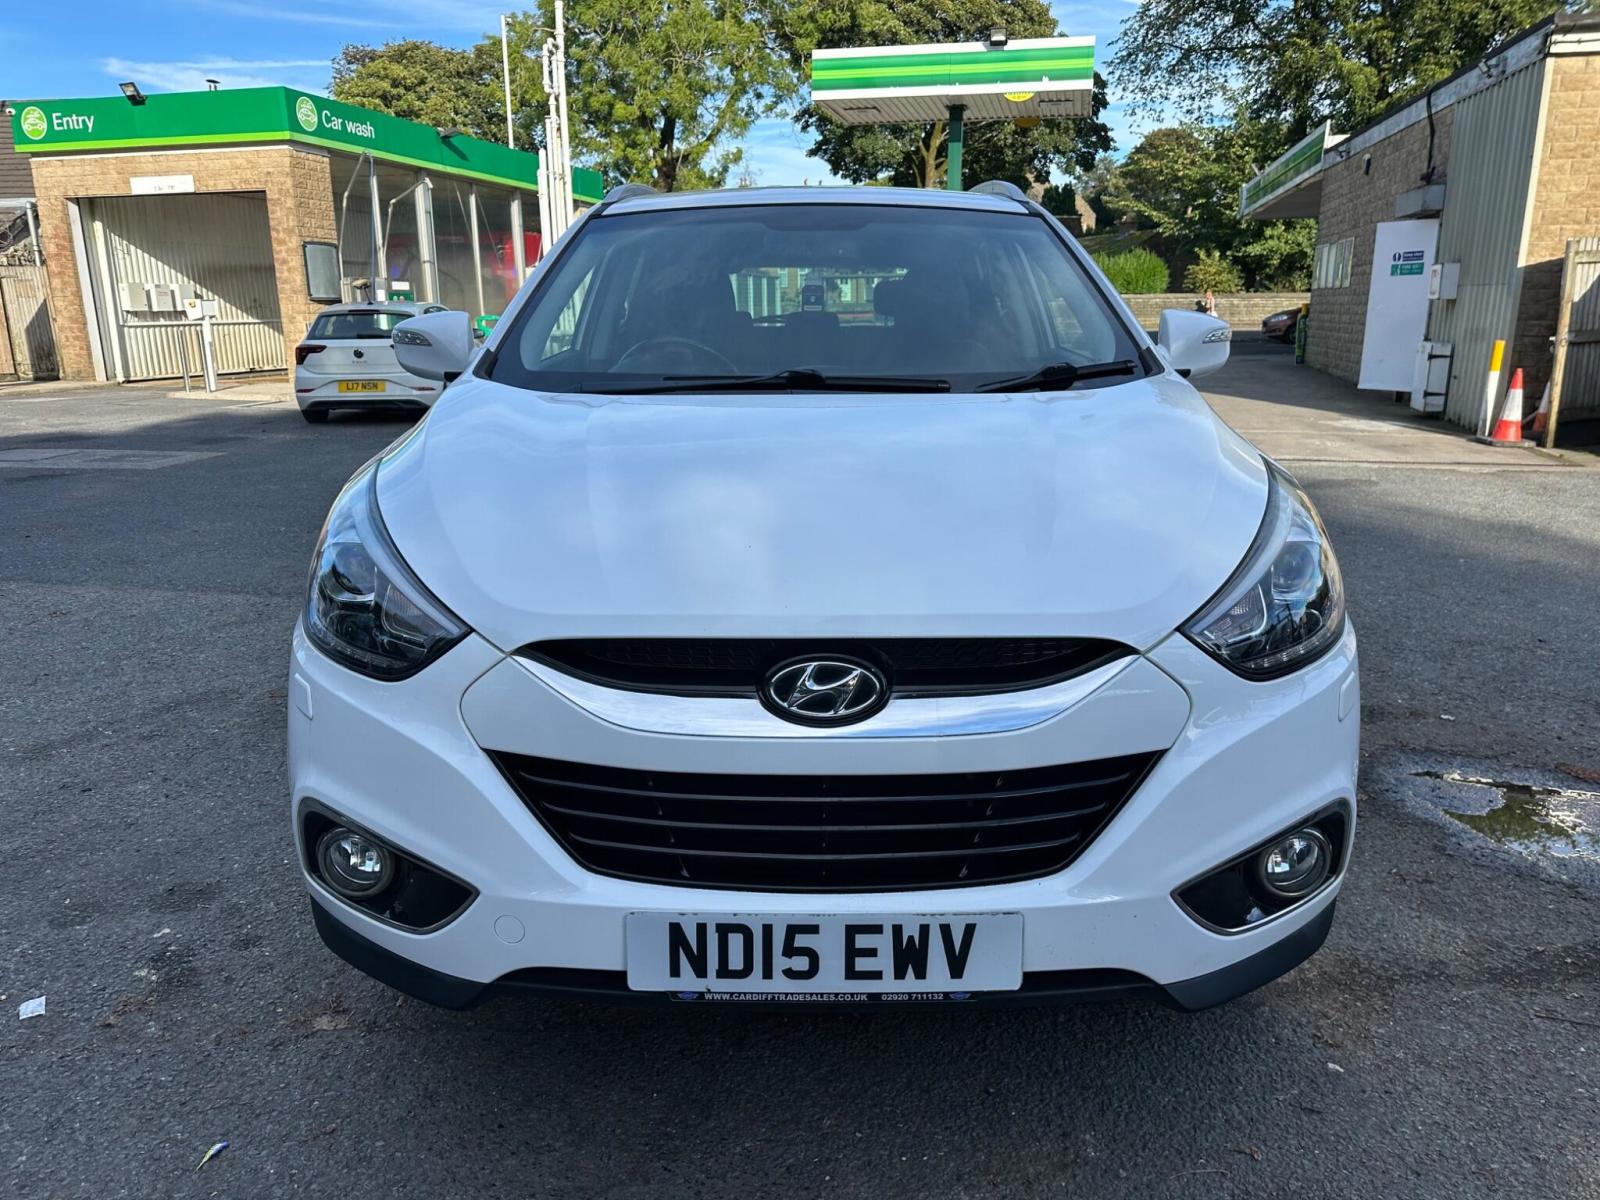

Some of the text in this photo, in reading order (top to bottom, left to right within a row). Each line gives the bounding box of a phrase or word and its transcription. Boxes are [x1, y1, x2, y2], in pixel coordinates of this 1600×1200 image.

[52, 112, 94, 133] Entry
[321, 110, 375, 139] Car wash
[668, 922, 977, 980] ND15 EWV
[704, 992, 868, 1001] WWW.CARDIFFTRADESALES.CO.UK
[881, 993, 909, 1001] 02920
